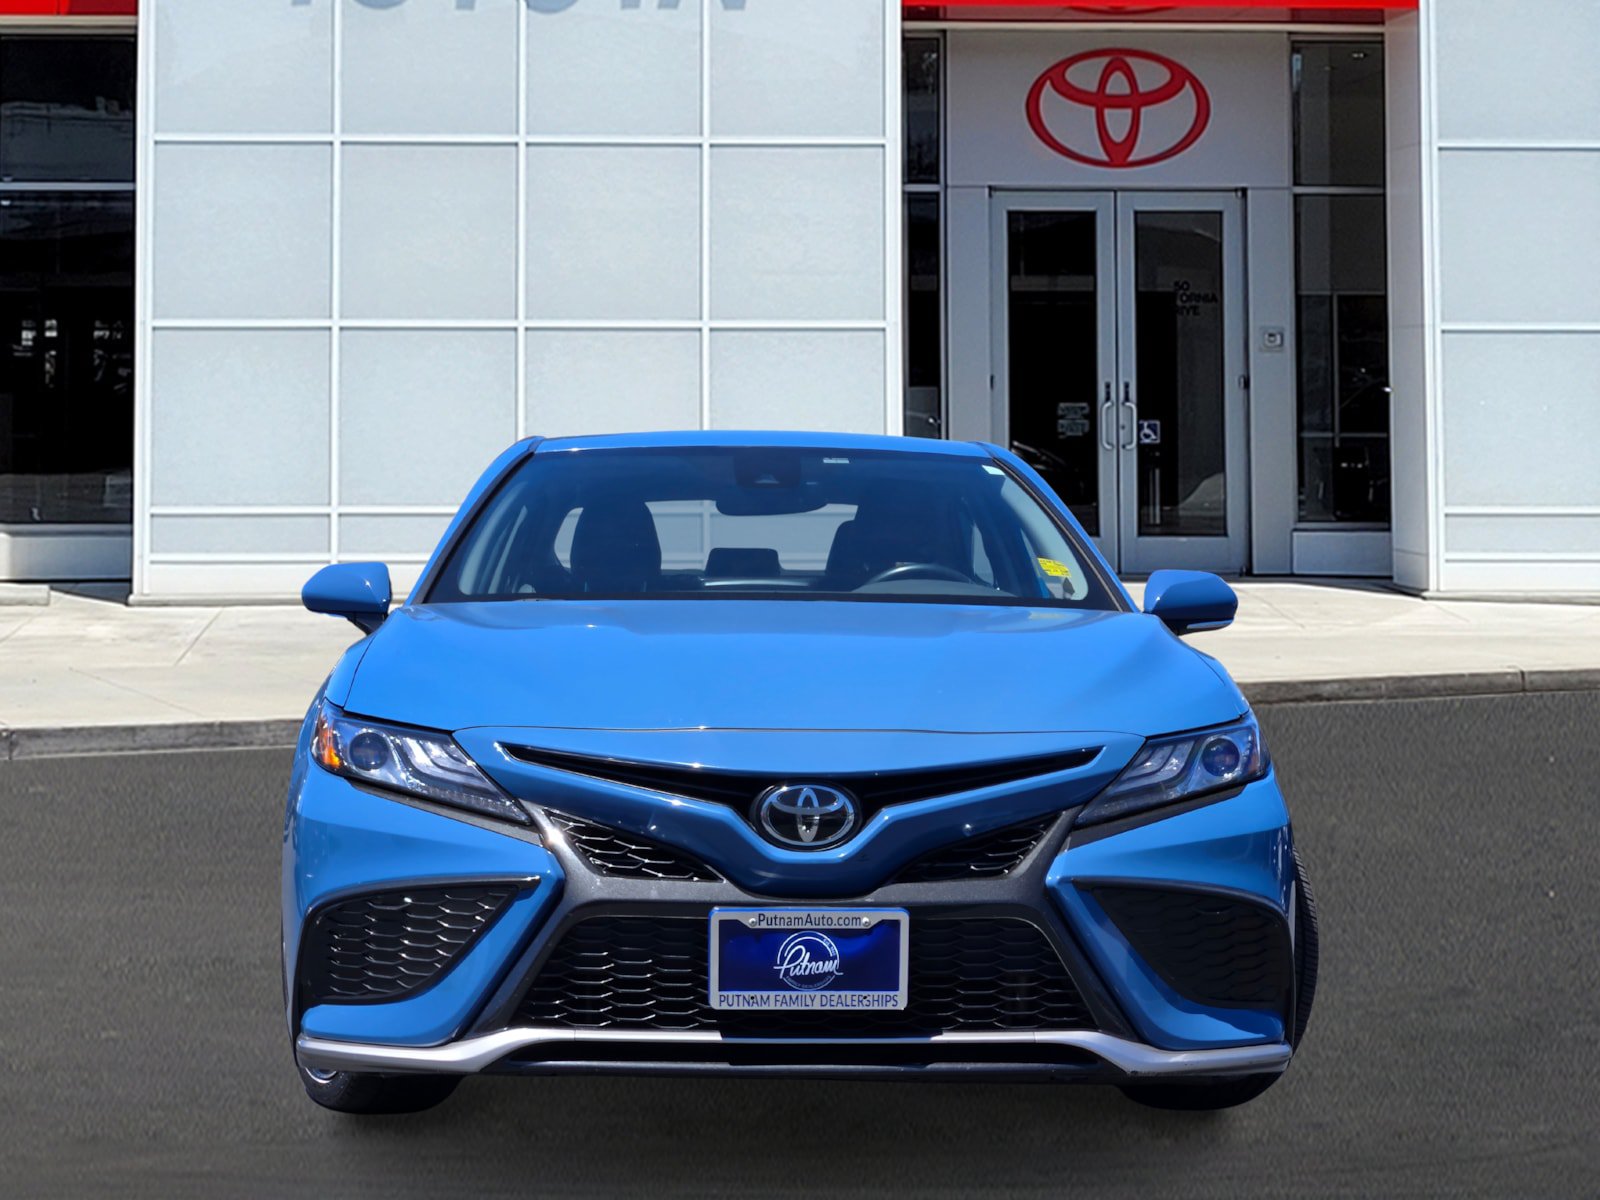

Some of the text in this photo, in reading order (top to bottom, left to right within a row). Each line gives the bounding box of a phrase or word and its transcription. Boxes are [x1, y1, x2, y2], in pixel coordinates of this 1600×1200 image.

[757, 913, 862, 927] PutnamAuto.com
[773, 945, 844, 979] Putnam
[719, 994, 899, 1007] PUTNAM FAMILY DEALERSHIPS
